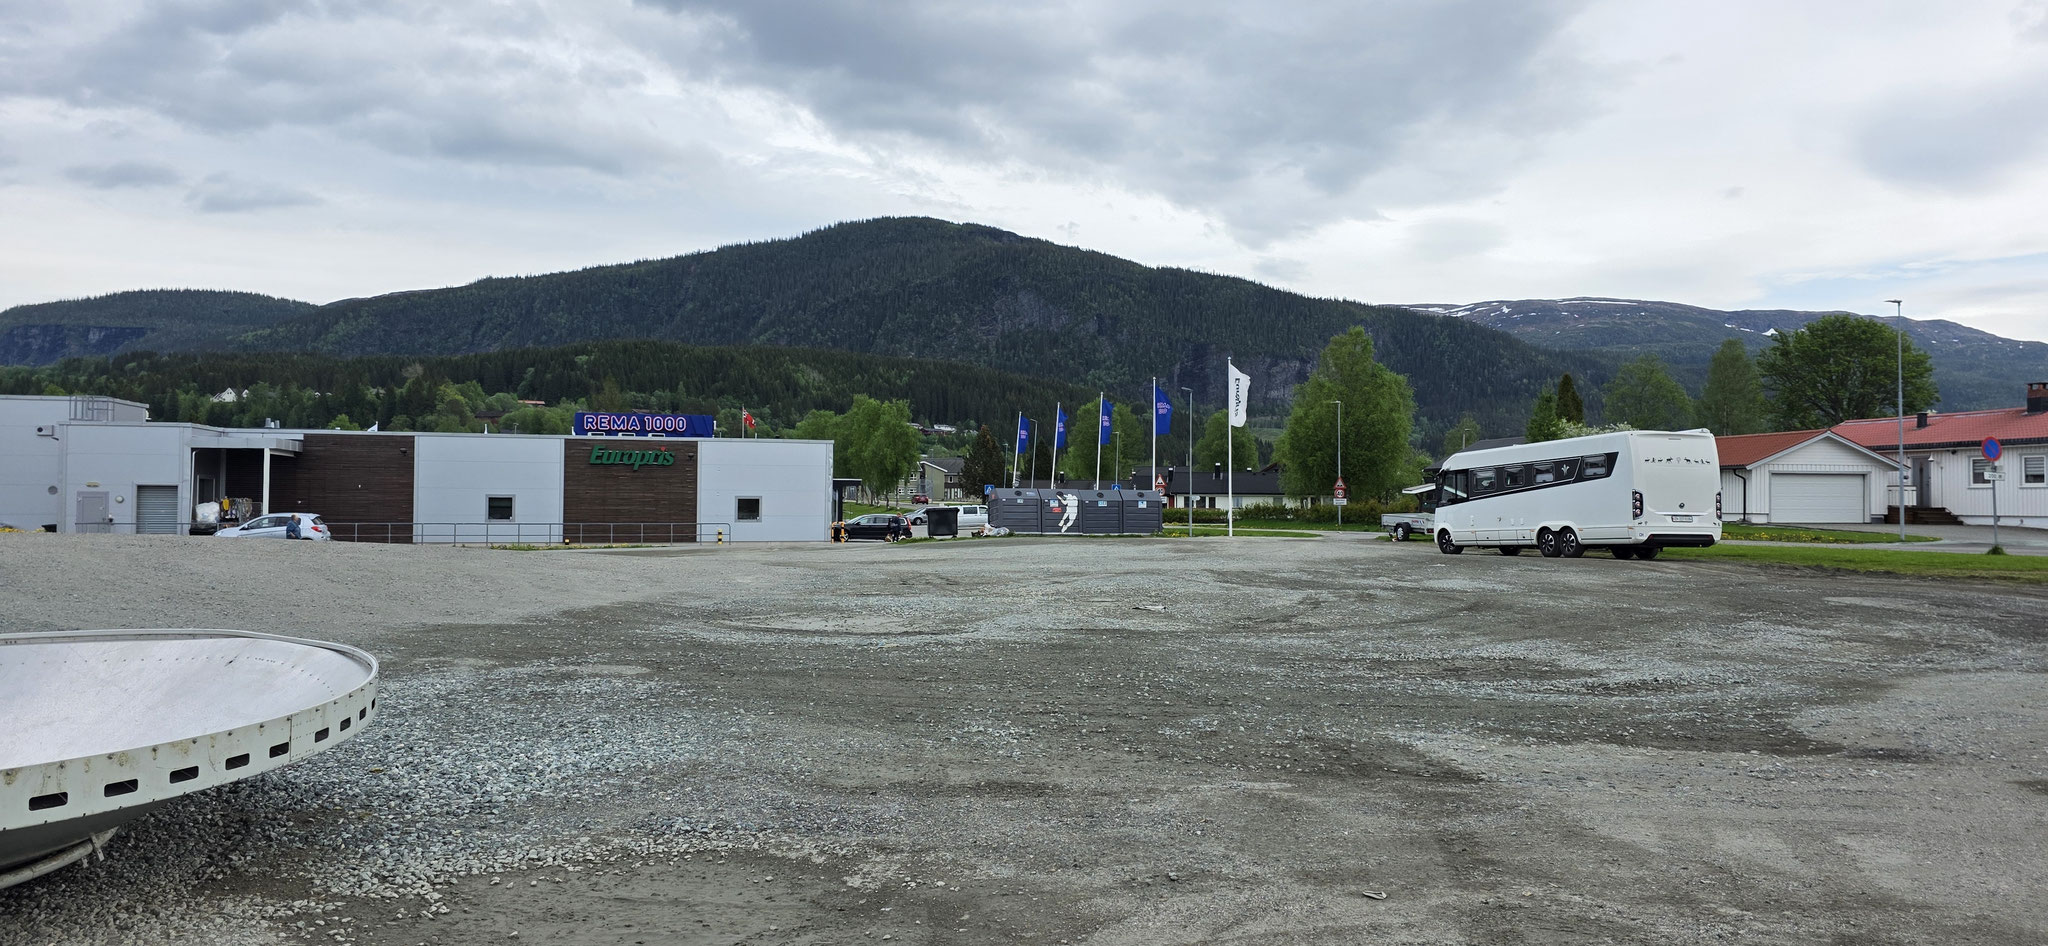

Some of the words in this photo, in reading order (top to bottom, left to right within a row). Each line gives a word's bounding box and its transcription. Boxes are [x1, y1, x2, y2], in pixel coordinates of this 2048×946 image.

[584, 415, 640, 430] REMA
[644, 416, 687, 431] 1000
[590, 445, 675, 470] Europris
